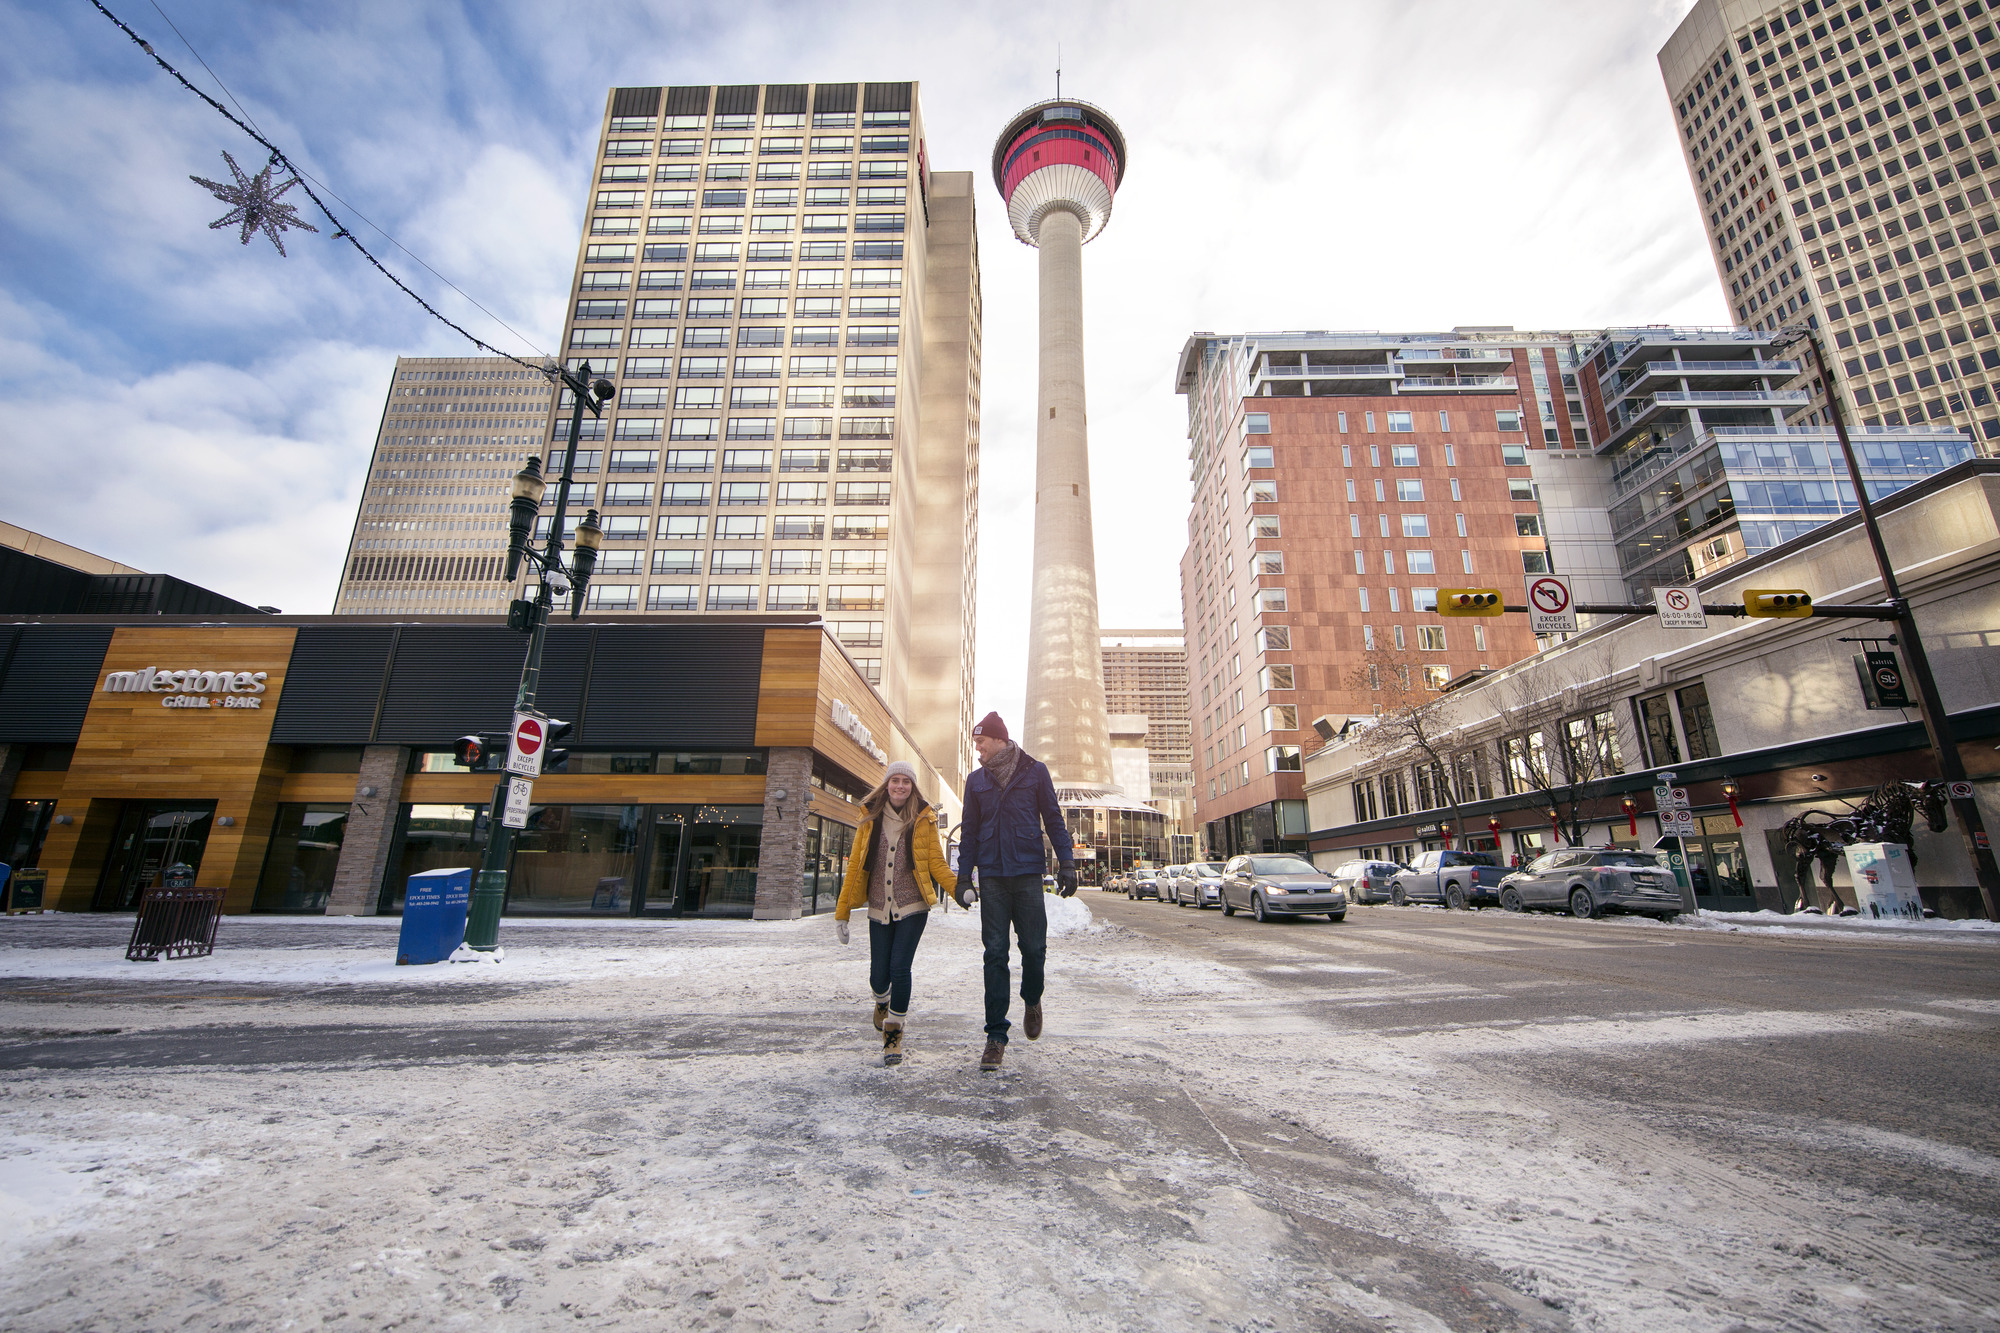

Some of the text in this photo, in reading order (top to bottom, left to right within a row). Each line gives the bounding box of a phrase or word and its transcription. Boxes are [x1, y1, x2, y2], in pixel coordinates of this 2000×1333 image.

[102, 666, 268, 693] milestones
[161, 695, 211, 709] GRILL
[223, 695, 262, 709] BAR
[517, 754, 534, 764] EXCEPT
[513, 762, 536, 773] BICYCLES
[506, 806, 527, 814] PEDESTRIAN
